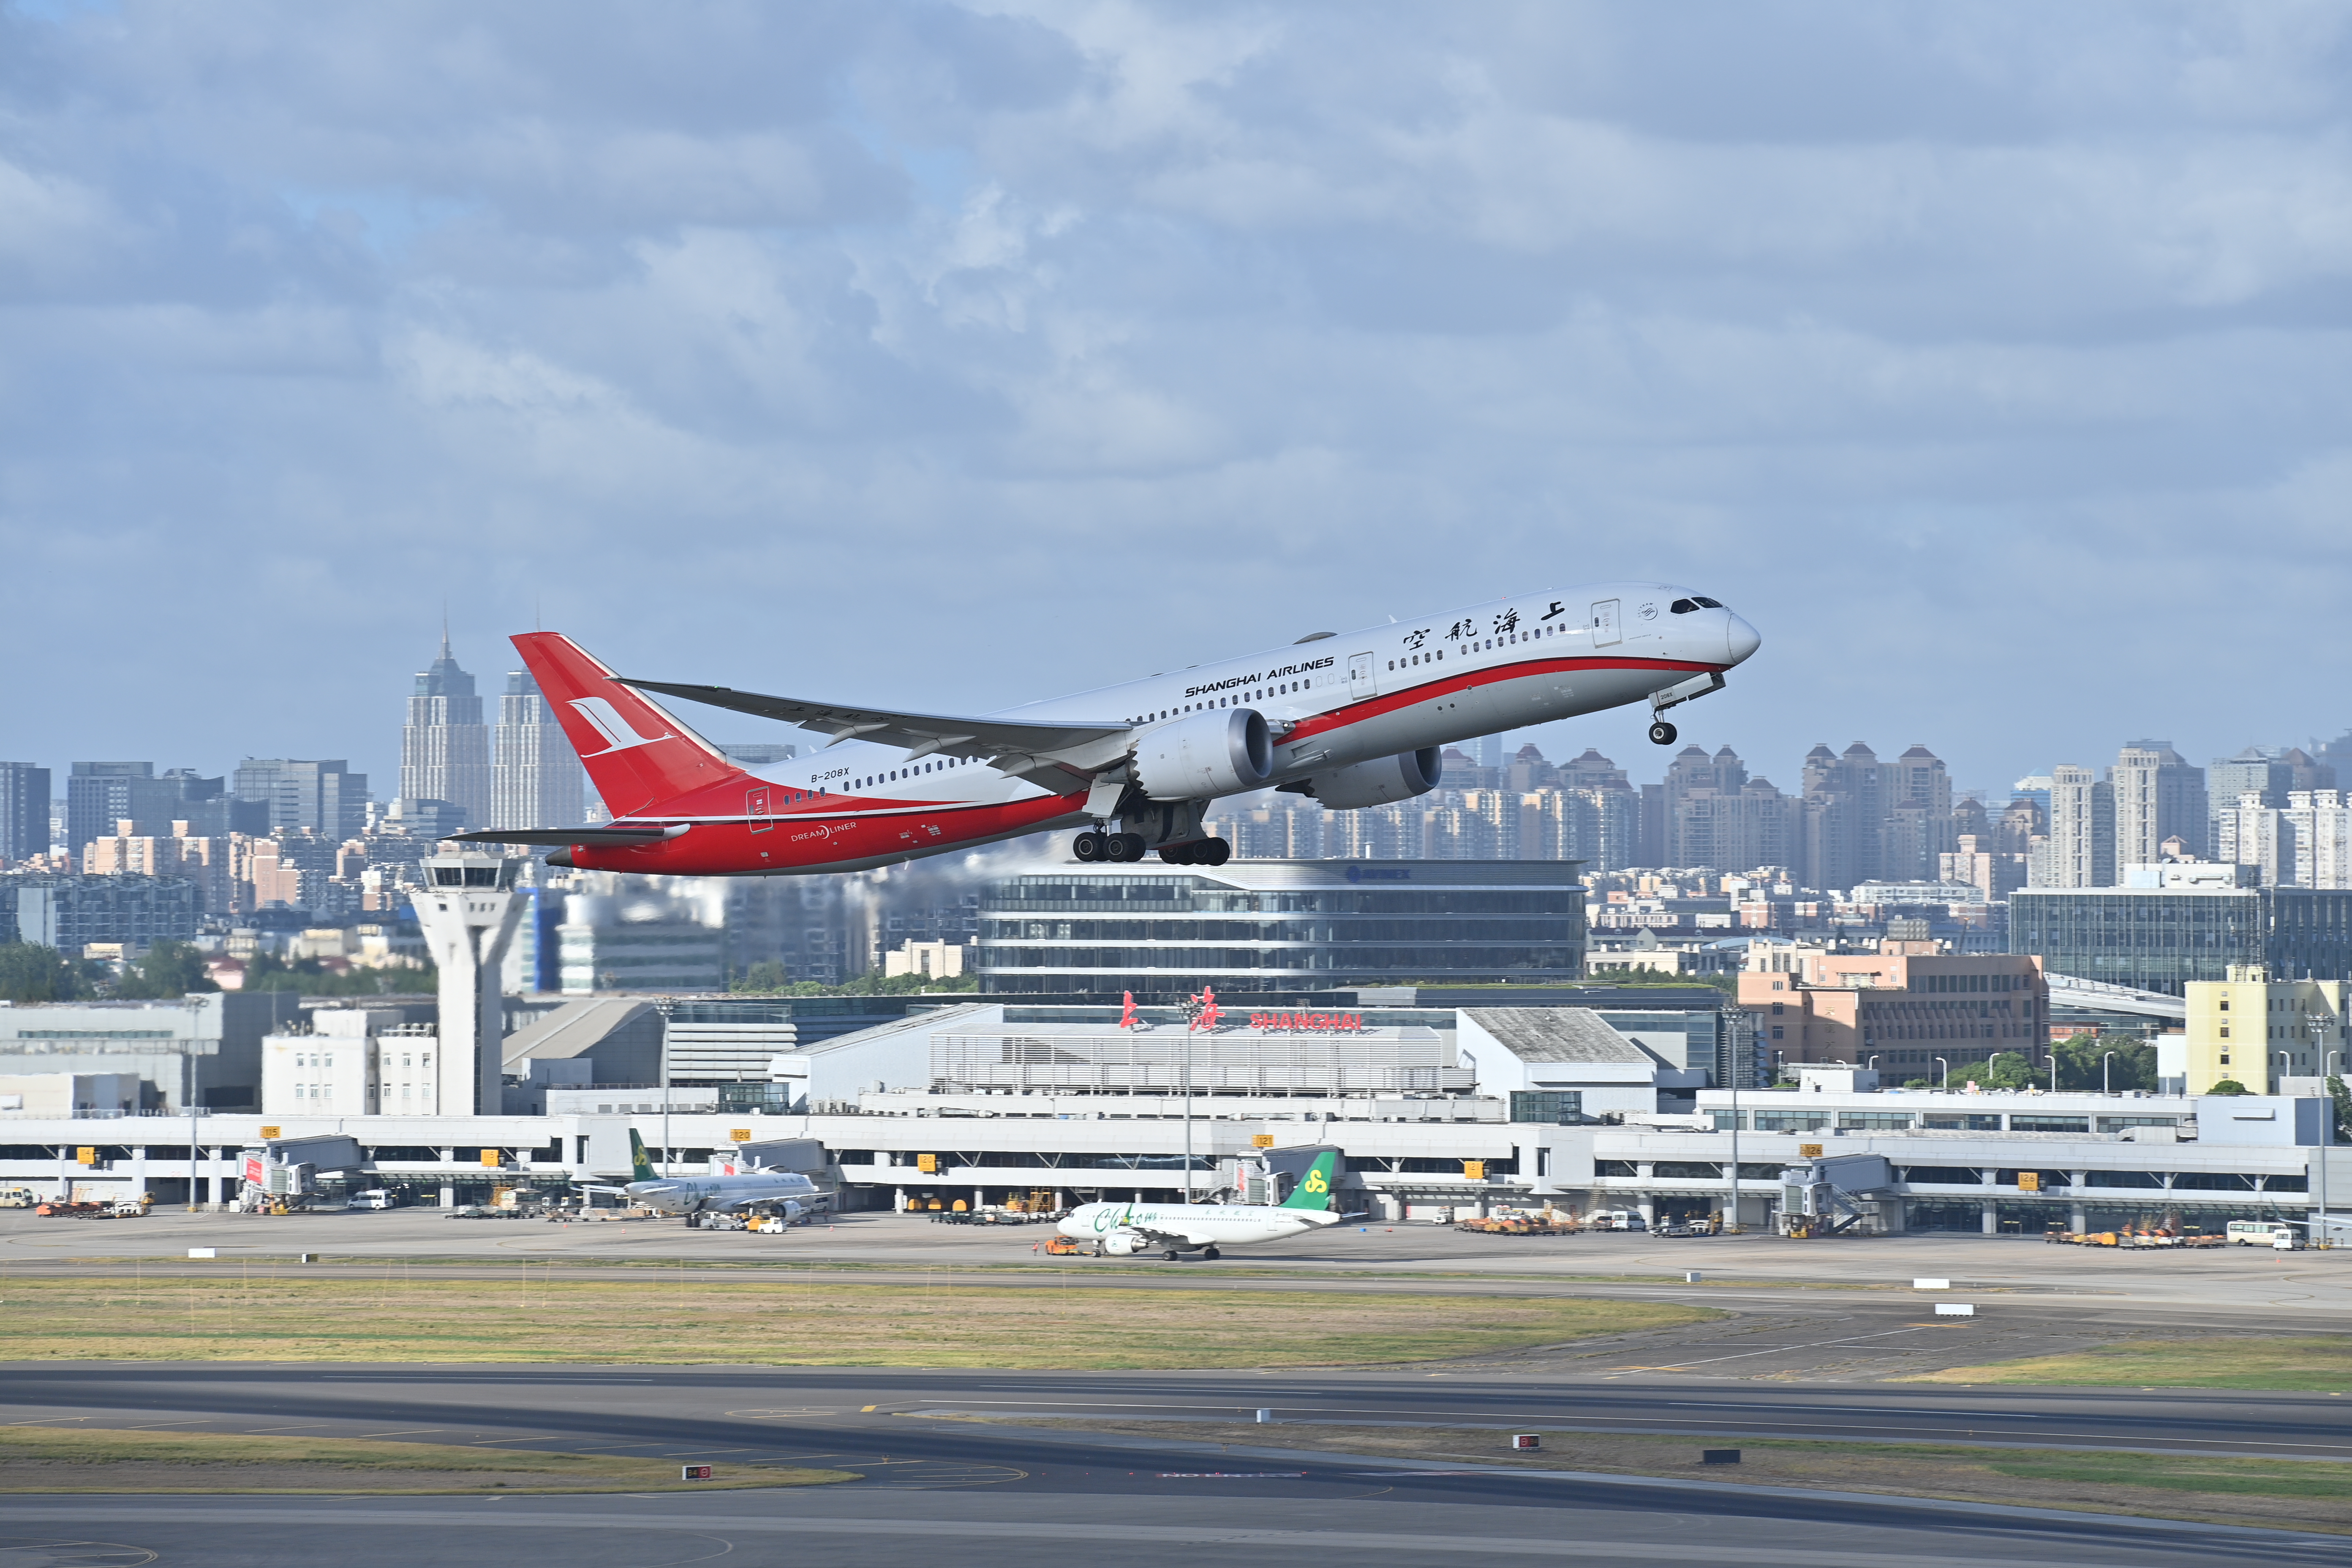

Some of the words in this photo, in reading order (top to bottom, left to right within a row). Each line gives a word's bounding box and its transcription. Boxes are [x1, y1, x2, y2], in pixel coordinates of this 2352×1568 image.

[1185, 672, 1261, 698] SHANGHAI
[1267, 656, 1334, 680] AIRLINES
[811, 767, 849, 783] B-208X
[791, 822, 857, 841] DREAMLINER
[1119, 986, 1225, 1031] 上海
[1250, 1013, 1361, 1029] SHANGHAI
